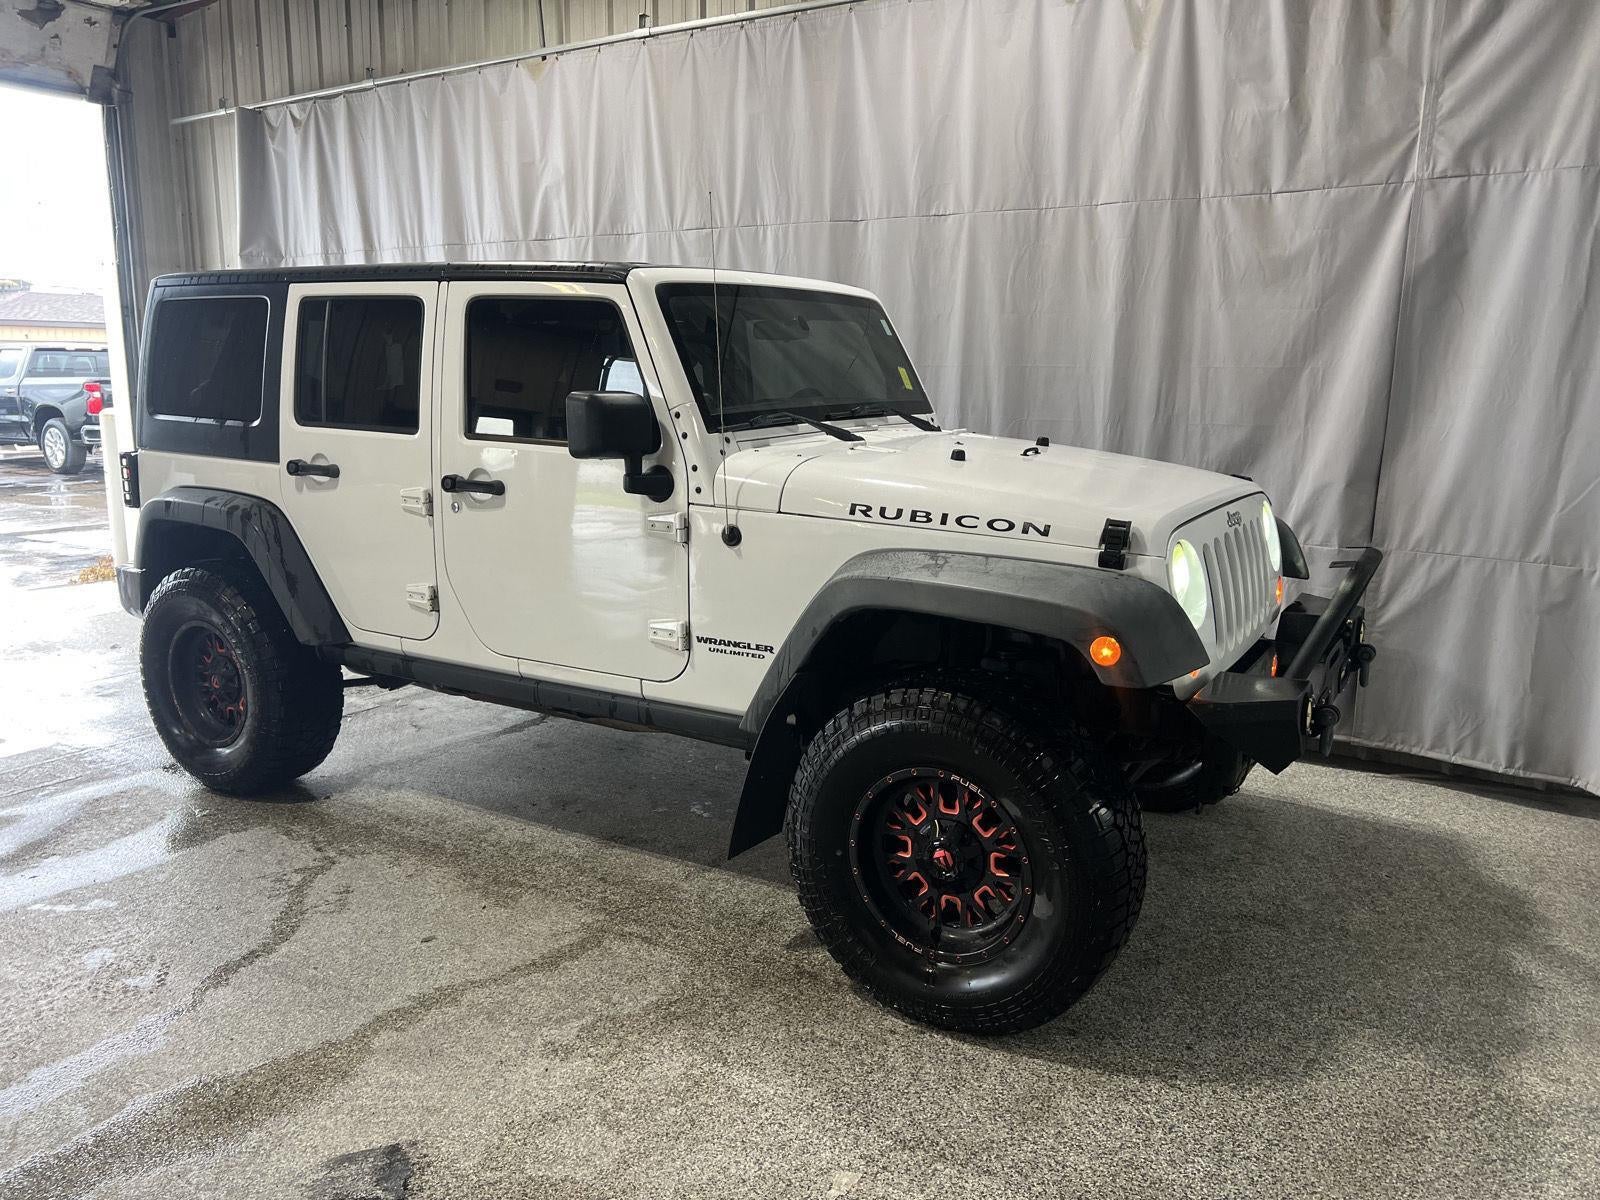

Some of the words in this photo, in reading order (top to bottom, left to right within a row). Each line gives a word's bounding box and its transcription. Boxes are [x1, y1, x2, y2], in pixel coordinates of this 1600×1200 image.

[848, 503, 1051, 537] RUBICON
[696, 636, 774, 654] WRANGLER
[708, 647, 765, 659] UNLIMITED
[950, 774, 984, 798] FUEL
[891, 929, 923, 954] FUEL
